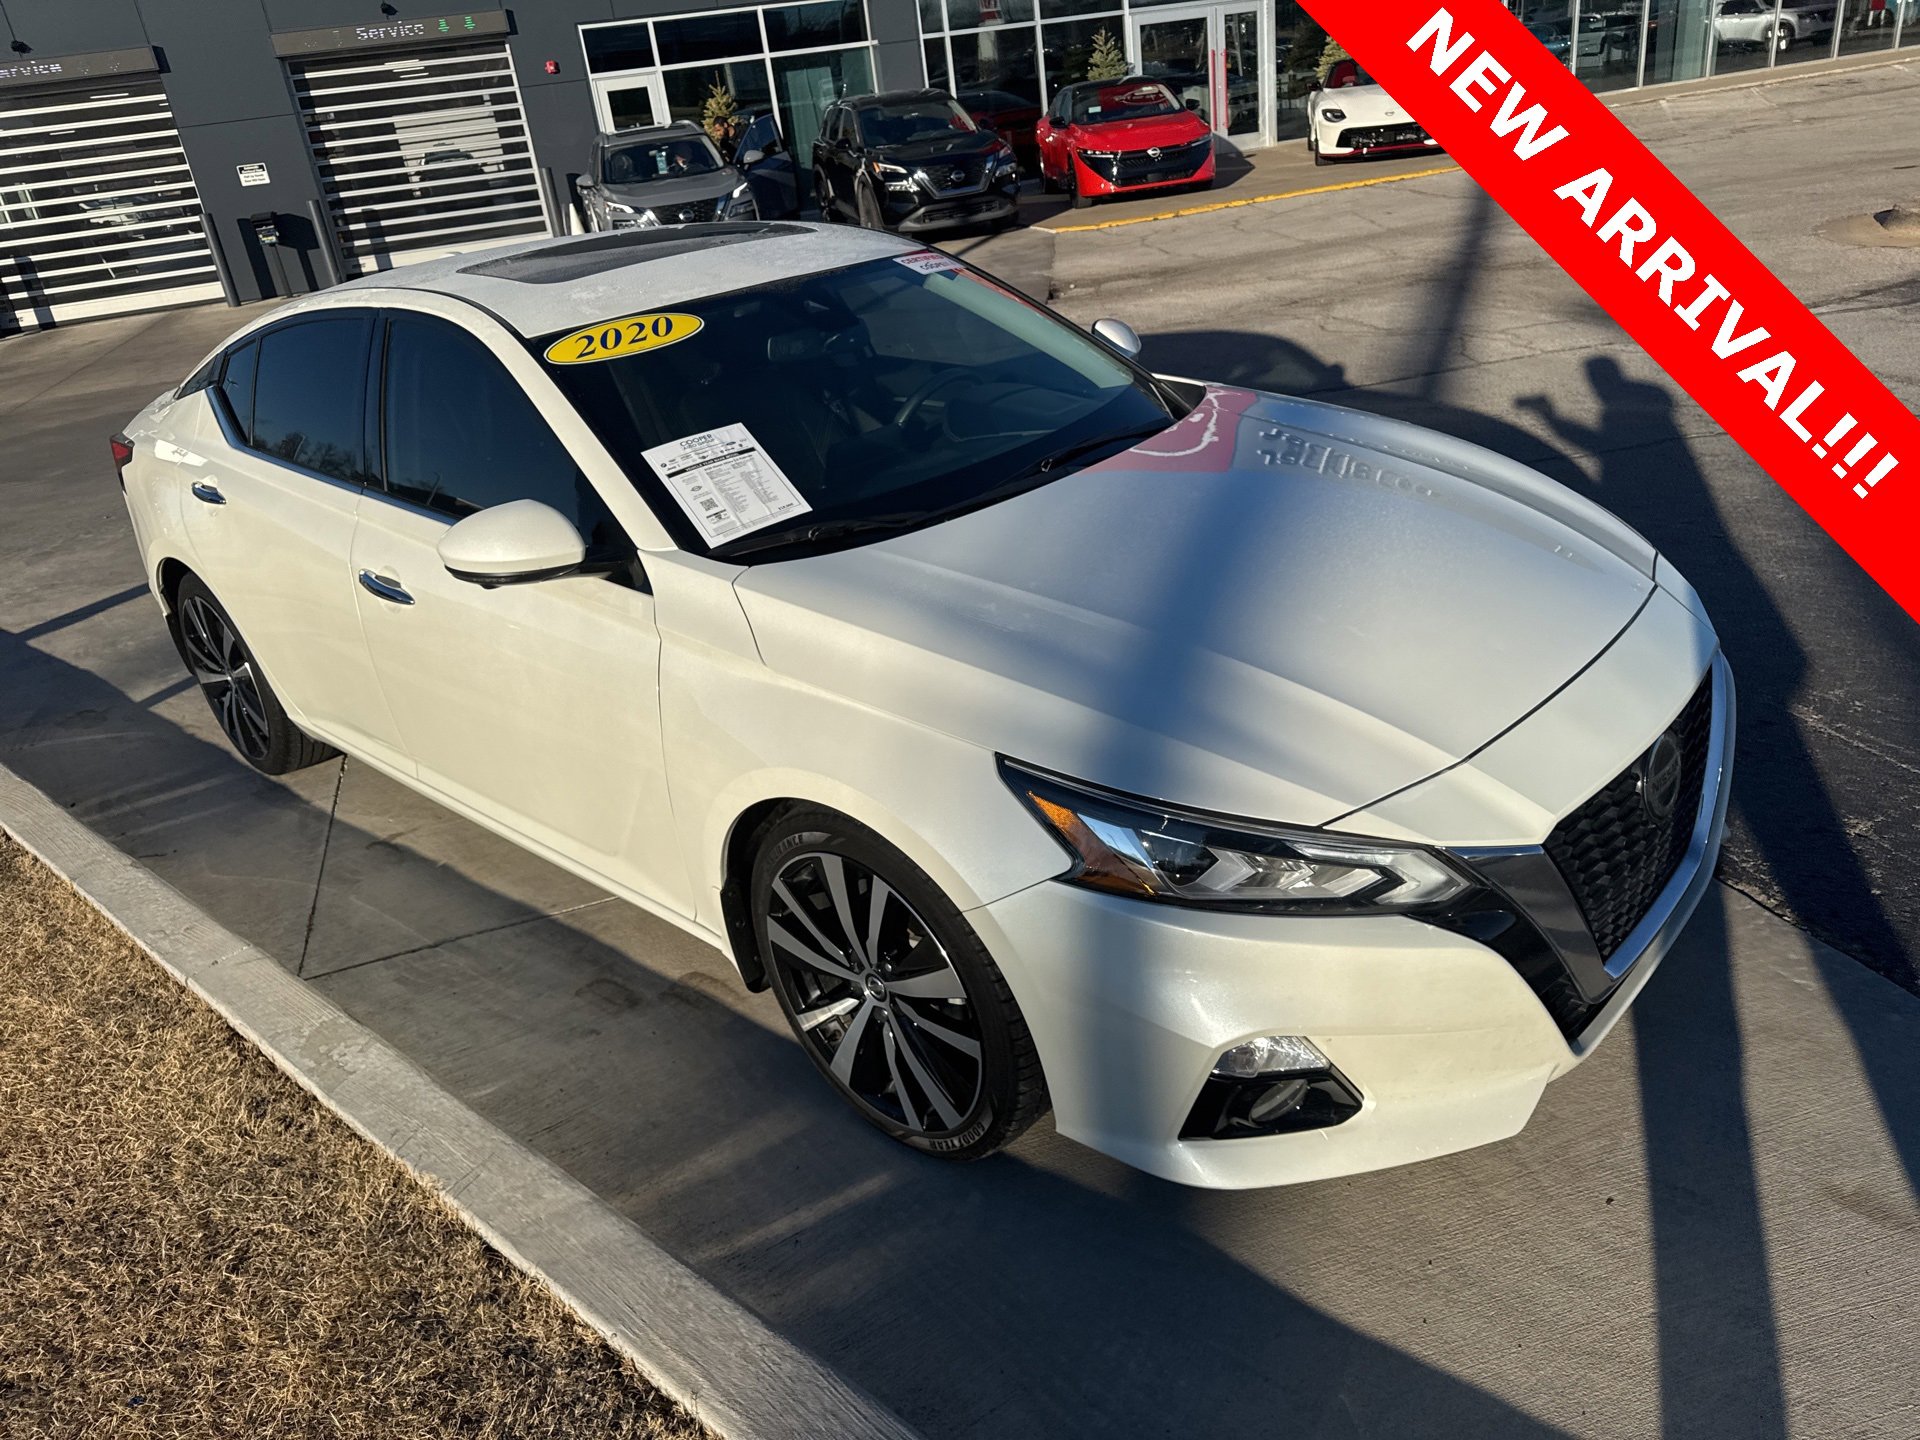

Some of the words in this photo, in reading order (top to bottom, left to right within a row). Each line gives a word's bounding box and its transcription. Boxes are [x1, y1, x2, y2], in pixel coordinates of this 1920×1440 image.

[355, 21, 424, 40] Service
[0, 61, 62, 78] ervice
[574, 316, 673, 359] 2020
[680, 433, 712, 447] COOPER
[929, 1121, 986, 1150] GOODYEAR
